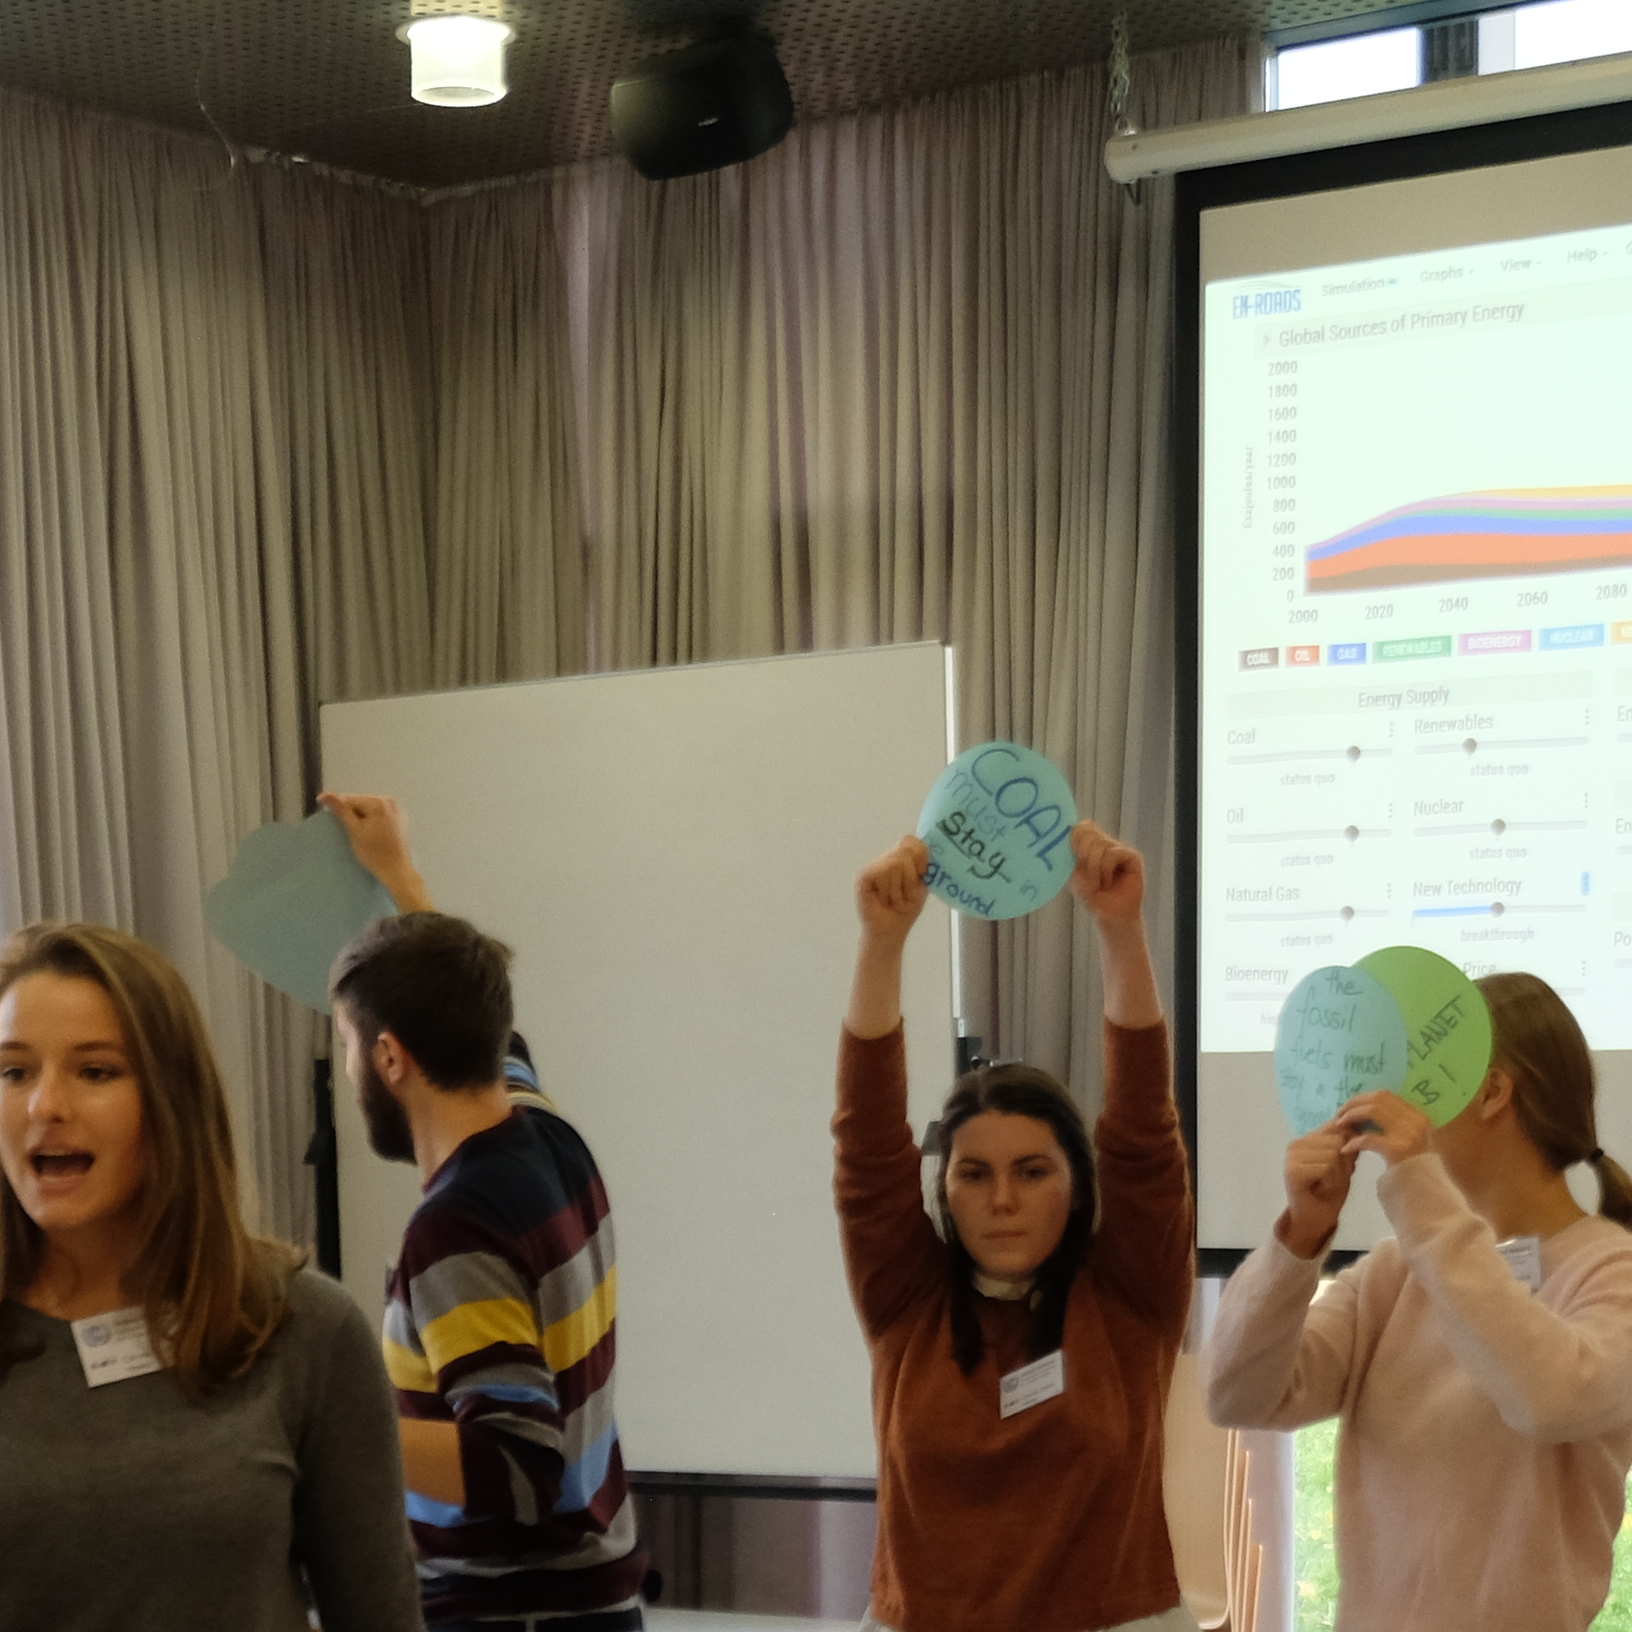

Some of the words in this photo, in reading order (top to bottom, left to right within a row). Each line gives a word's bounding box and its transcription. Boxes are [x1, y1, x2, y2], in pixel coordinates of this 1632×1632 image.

[1568, 247, 1597, 264] Help
[1500, 257, 1532, 272] View
[1420, 264, 1463, 284] Graphs
[1321, 277, 1384, 297] Simulation
[1279, 319, 1325, 348] Global
[1329, 314, 1386, 342] Sources
[1391, 310, 1408, 332] of
[1410, 306, 1468, 332] Primary
[1472, 302, 1525, 325] Energy
[1268, 361, 1298, 376] 2000
[1268, 383, 1298, 399] 1800
[1268, 406, 1297, 422] 1600
[1267, 429, 1297, 445] 1400
[1267, 452, 1296, 468] 1200
[1267, 475, 1296, 490] 1000
[1273, 498, 1296, 513] 800
[1272, 521, 1295, 536] 600
[1272, 544, 1295, 558] 400
[1272, 567, 1294, 581] 200
[1516, 591, 1548, 607] 2060
[1595, 584, 1627, 600] 2080
[1364, 605, 1394, 621] 2020
[1439, 597, 1469, 613] 2040
[1288, 609, 1318, 625] 2000
[1358, 690, 1402, 708] Energy
[1406, 687, 1450, 706] Supply
[1414, 715, 1493, 734] Renewables
[1227, 730, 1255, 745] Coal
[971, 749, 1073, 873] COAL
[1226, 808, 1244, 824] Oil
[1414, 799, 1464, 817] Nuclear
[936, 810, 1011, 884] Stay
[1226, 886, 1271, 903] Natural
[1274, 886, 1300, 902] Gas
[1413, 881, 1442, 898] New
[1446, 877, 1521, 897] Technology
[1225, 966, 1289, 985] Bioenergy
